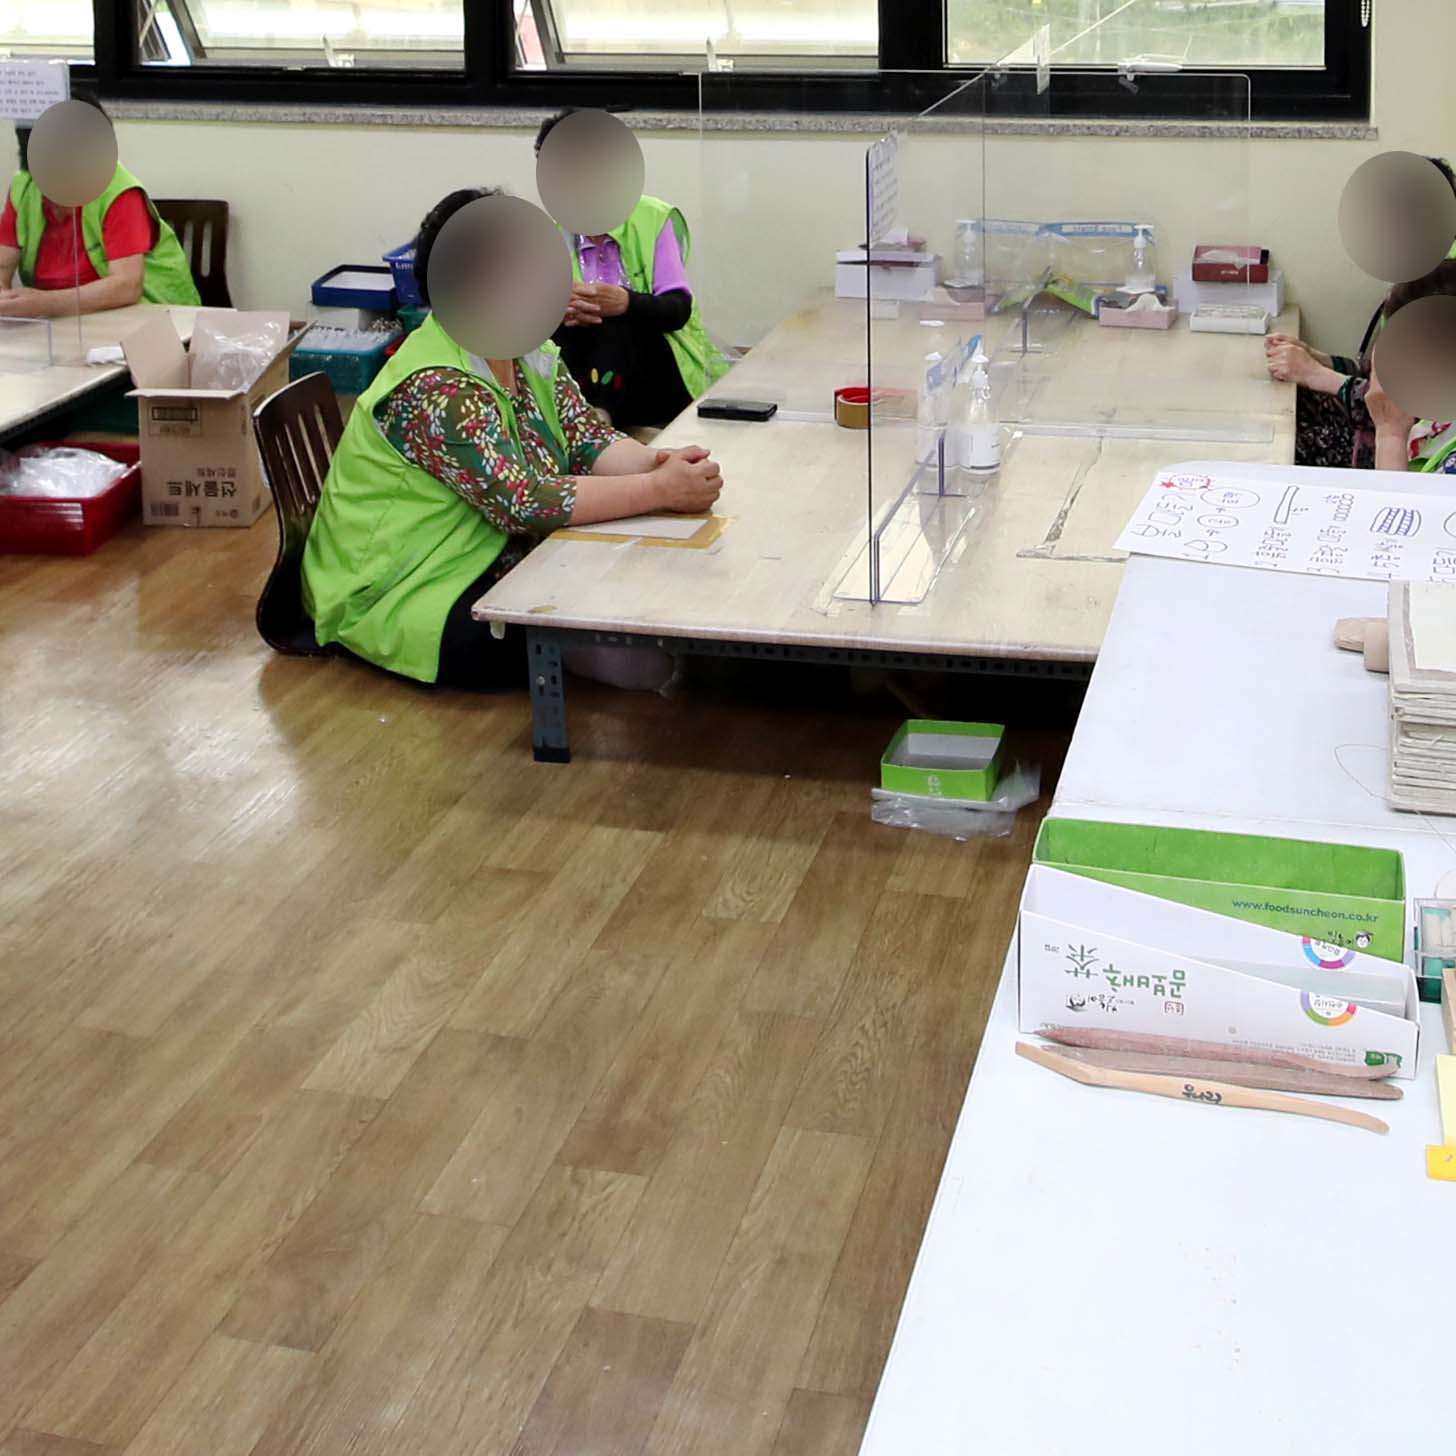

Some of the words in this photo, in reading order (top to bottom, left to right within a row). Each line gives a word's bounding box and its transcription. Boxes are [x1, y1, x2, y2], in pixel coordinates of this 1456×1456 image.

[167, 480, 237, 498] 선물세트
[1232, 898, 1380, 923] www.foodsuncheon.co.kr
[1103, 964, 1187, 1000] 곰보배추
